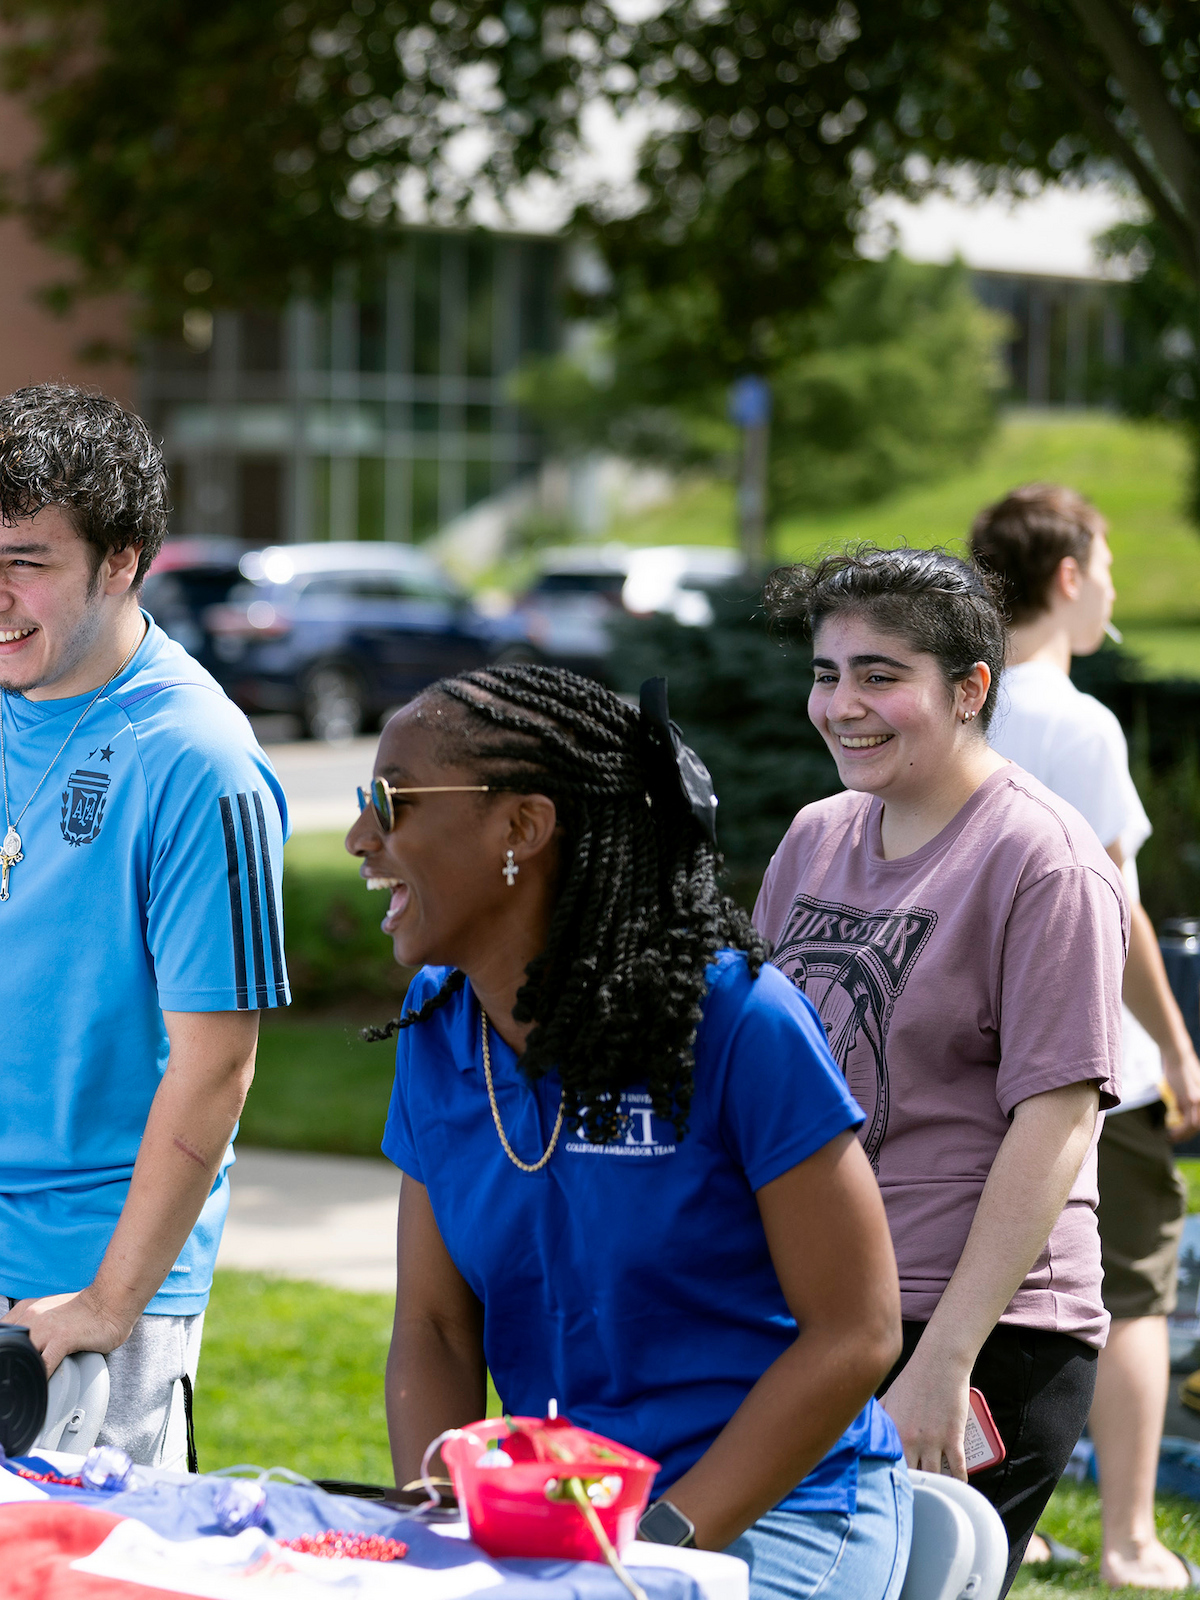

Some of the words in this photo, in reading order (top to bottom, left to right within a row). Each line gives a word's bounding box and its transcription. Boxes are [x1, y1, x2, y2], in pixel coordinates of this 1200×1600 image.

[72, 790, 97, 826] AFA
[780, 906, 920, 969] AIRWALK
[653, 1144, 676, 1155] TEAM
